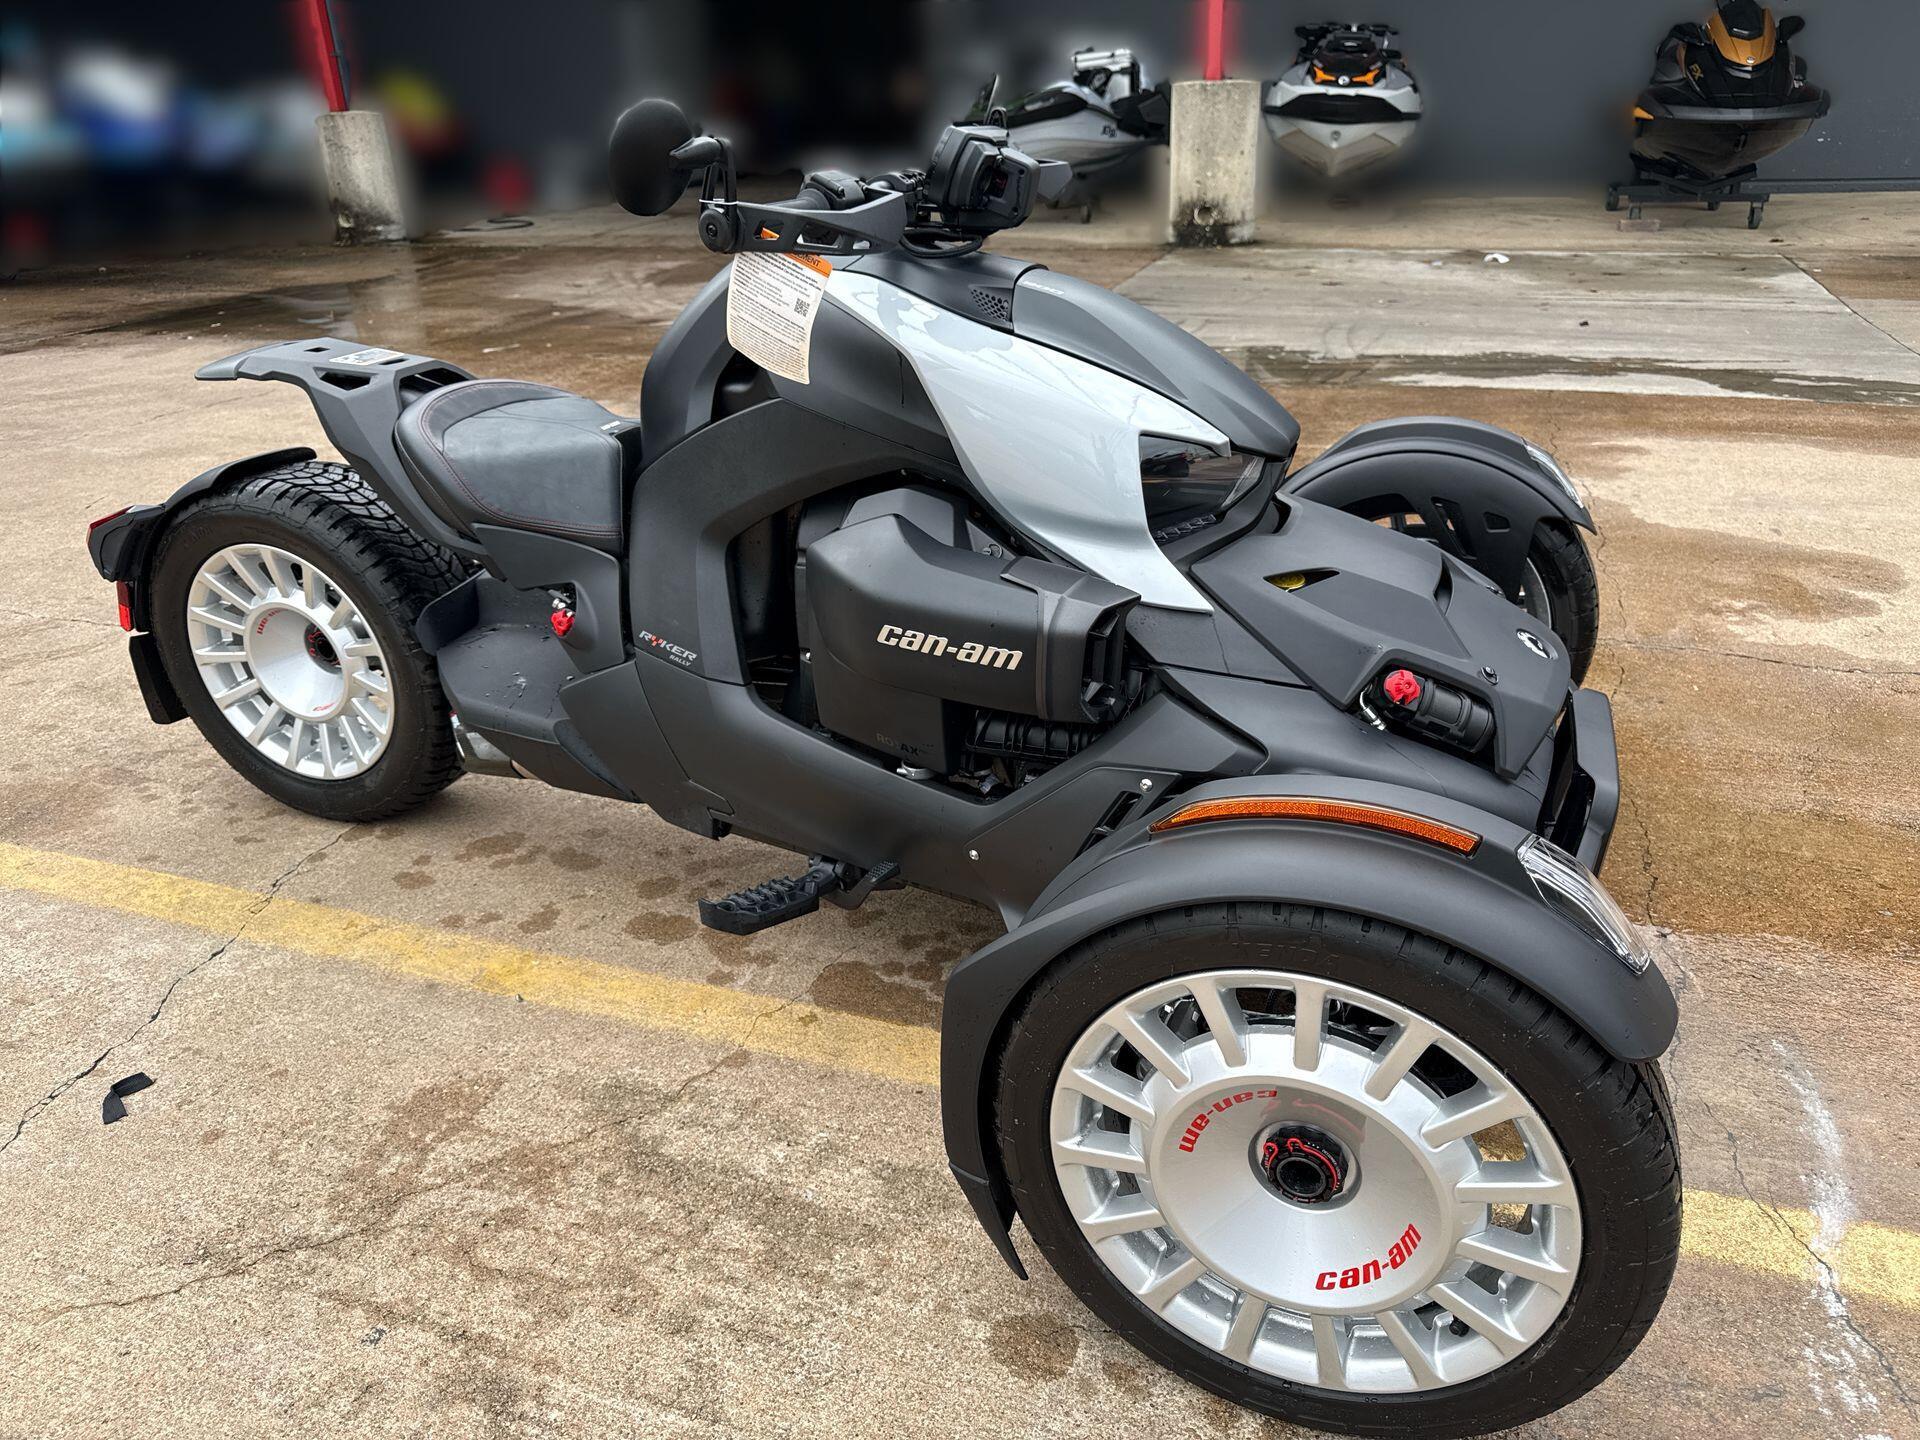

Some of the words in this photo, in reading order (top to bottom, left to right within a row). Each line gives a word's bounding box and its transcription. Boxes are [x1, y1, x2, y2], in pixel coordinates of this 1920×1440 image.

[639, 630, 697, 661] RYKER
[669, 654, 691, 666] RALLY
[876, 624, 1023, 670] can-am
[1178, 1089, 1278, 1153] can-am
[1315, 1223, 1422, 1291] can-am
